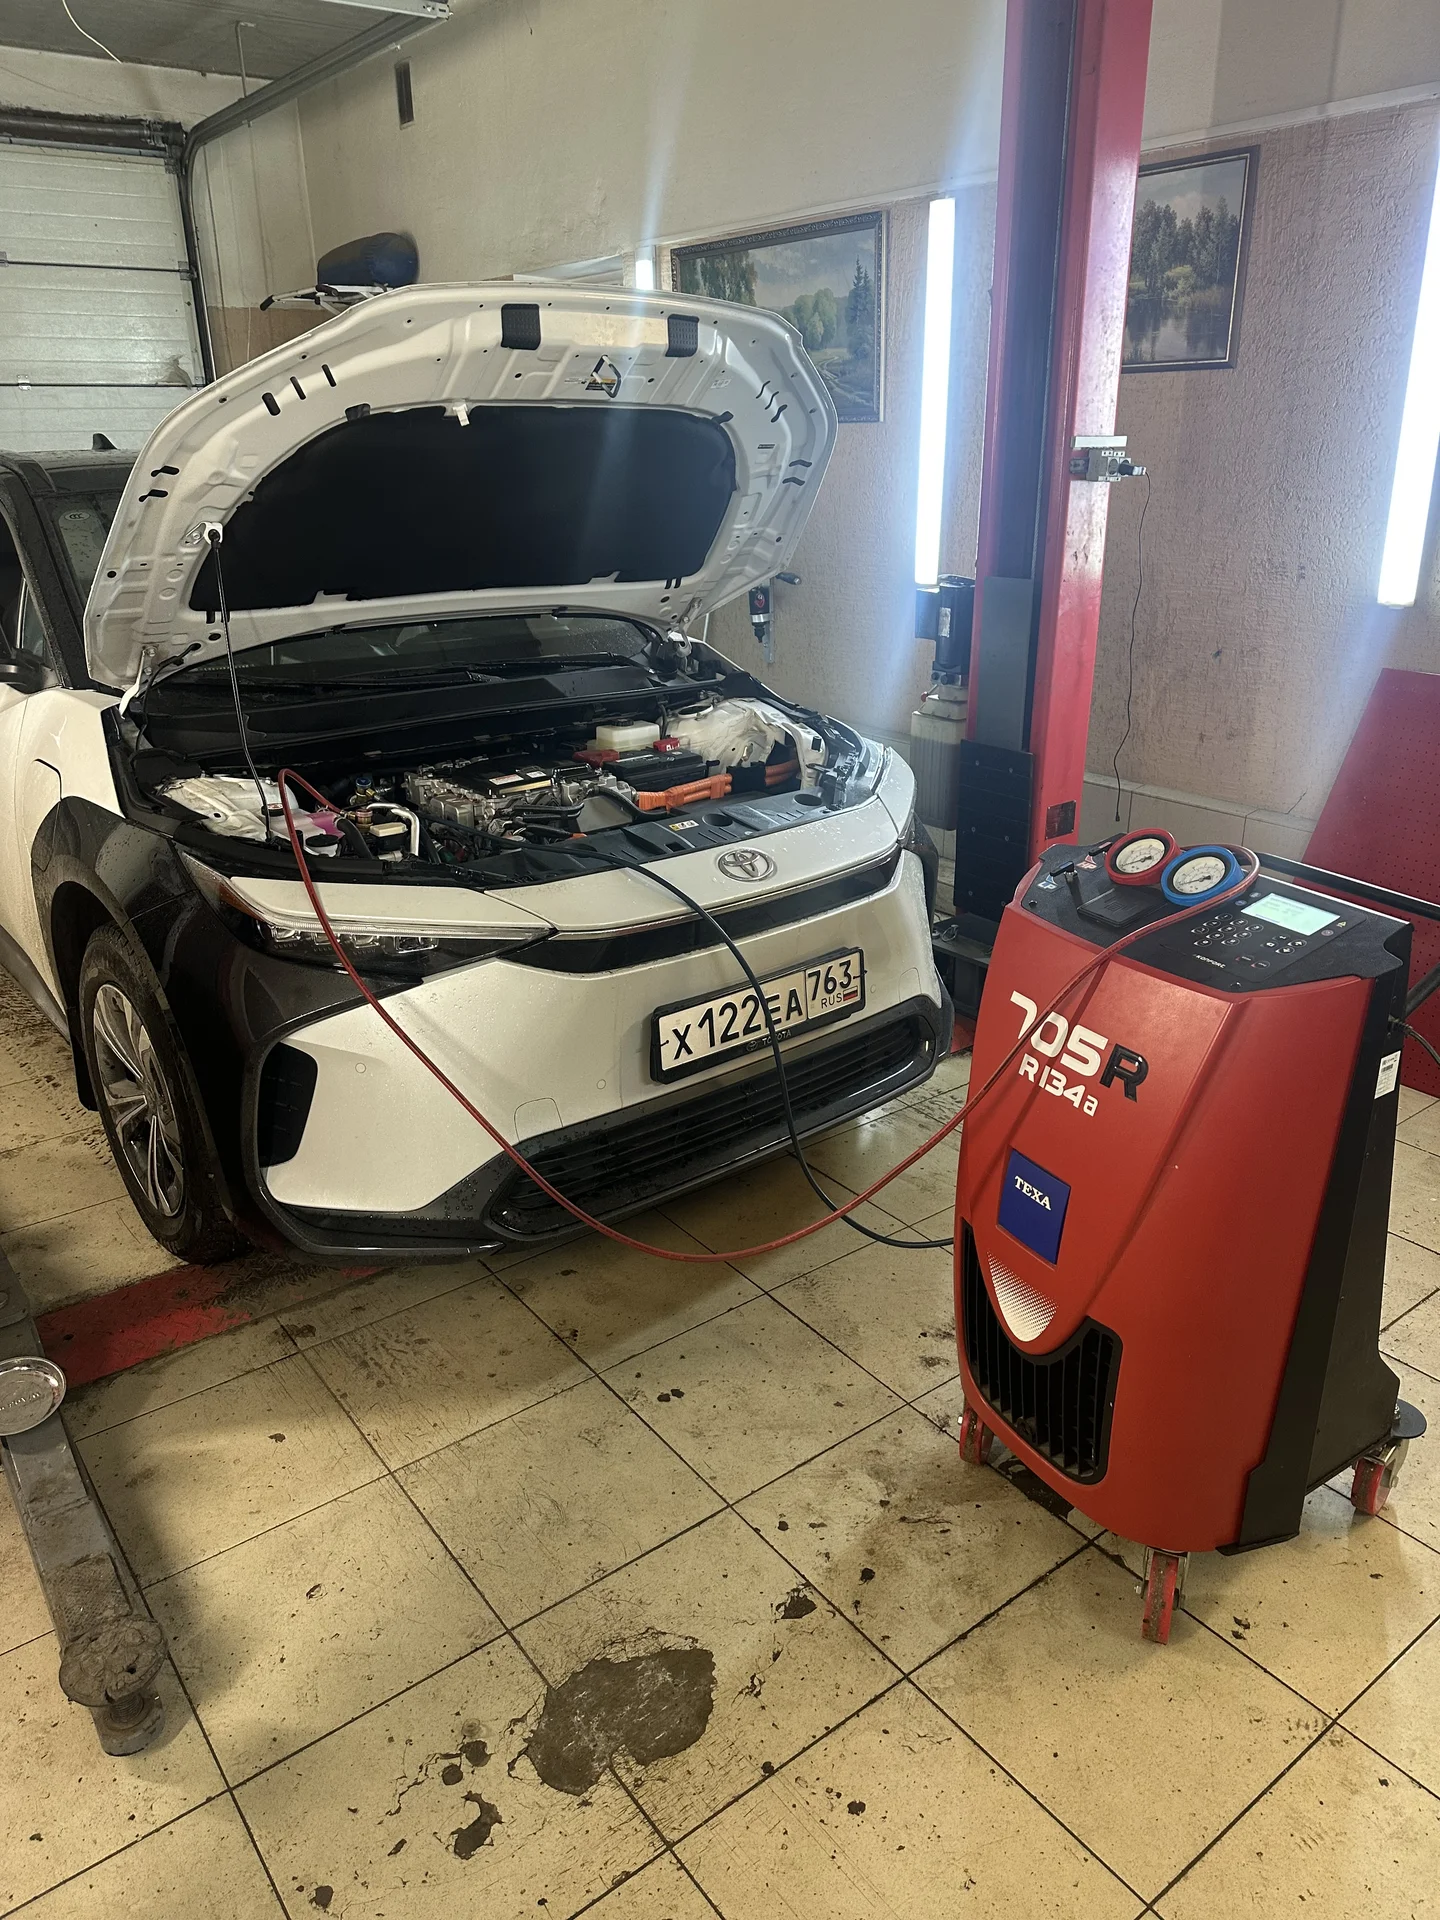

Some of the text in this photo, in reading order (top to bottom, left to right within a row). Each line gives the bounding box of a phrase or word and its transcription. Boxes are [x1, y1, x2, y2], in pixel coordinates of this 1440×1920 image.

[807, 960, 852, 1001] 763
[821, 992, 843, 1009] RUS
[762, 1030, 792, 1046] TOOTA
[1010, 990, 1149, 1102] 705R
[1019, 1053, 1099, 1117] R134a
[1014, 1175, 1052, 1211] TEXA
